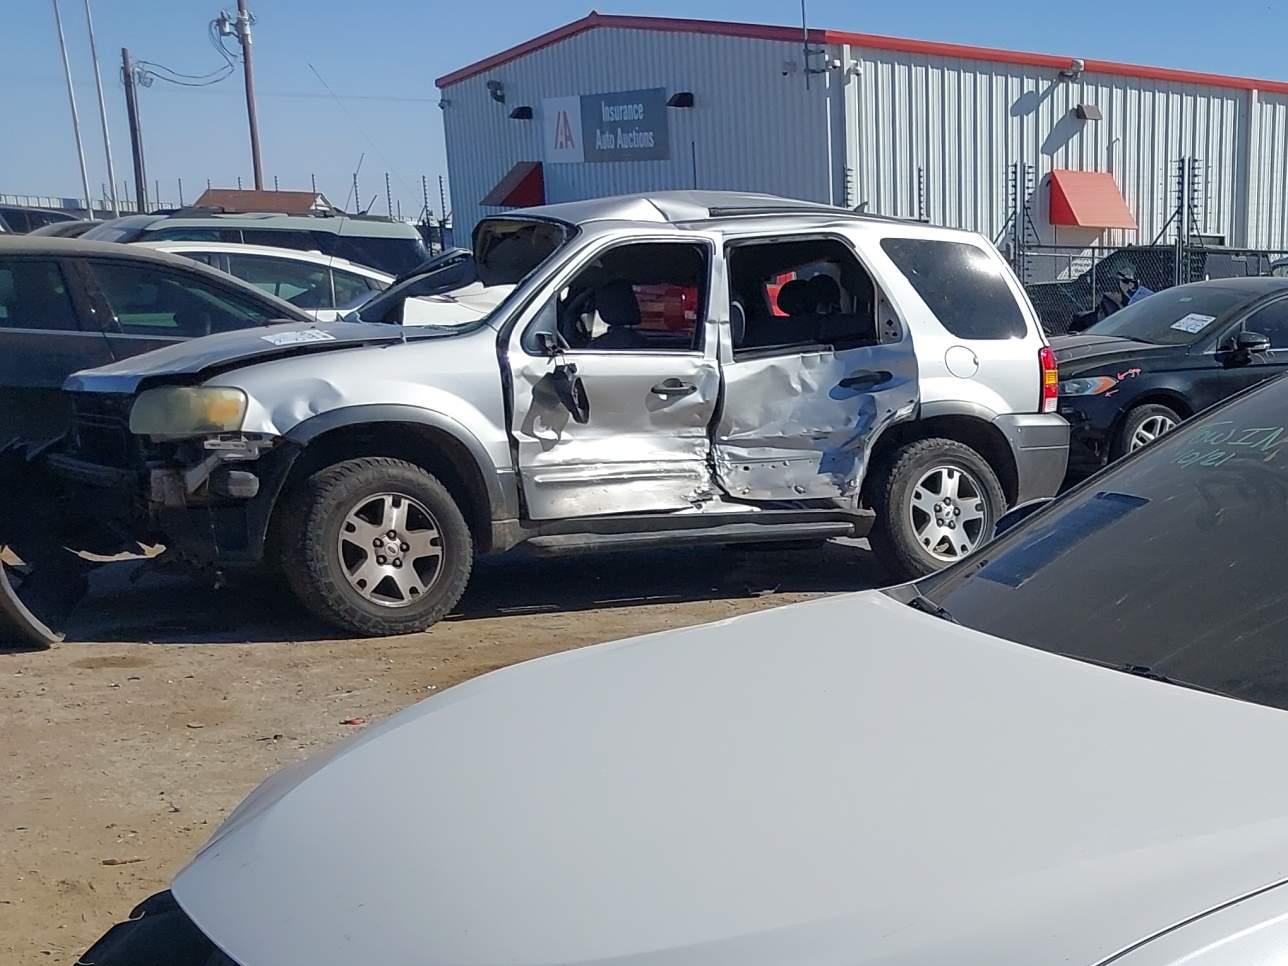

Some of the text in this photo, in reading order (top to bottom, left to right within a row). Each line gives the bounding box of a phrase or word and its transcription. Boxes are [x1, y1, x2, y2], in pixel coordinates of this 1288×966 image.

[602, 101, 645, 121] Insurance
[596, 127, 655, 150] Auto Auctions
